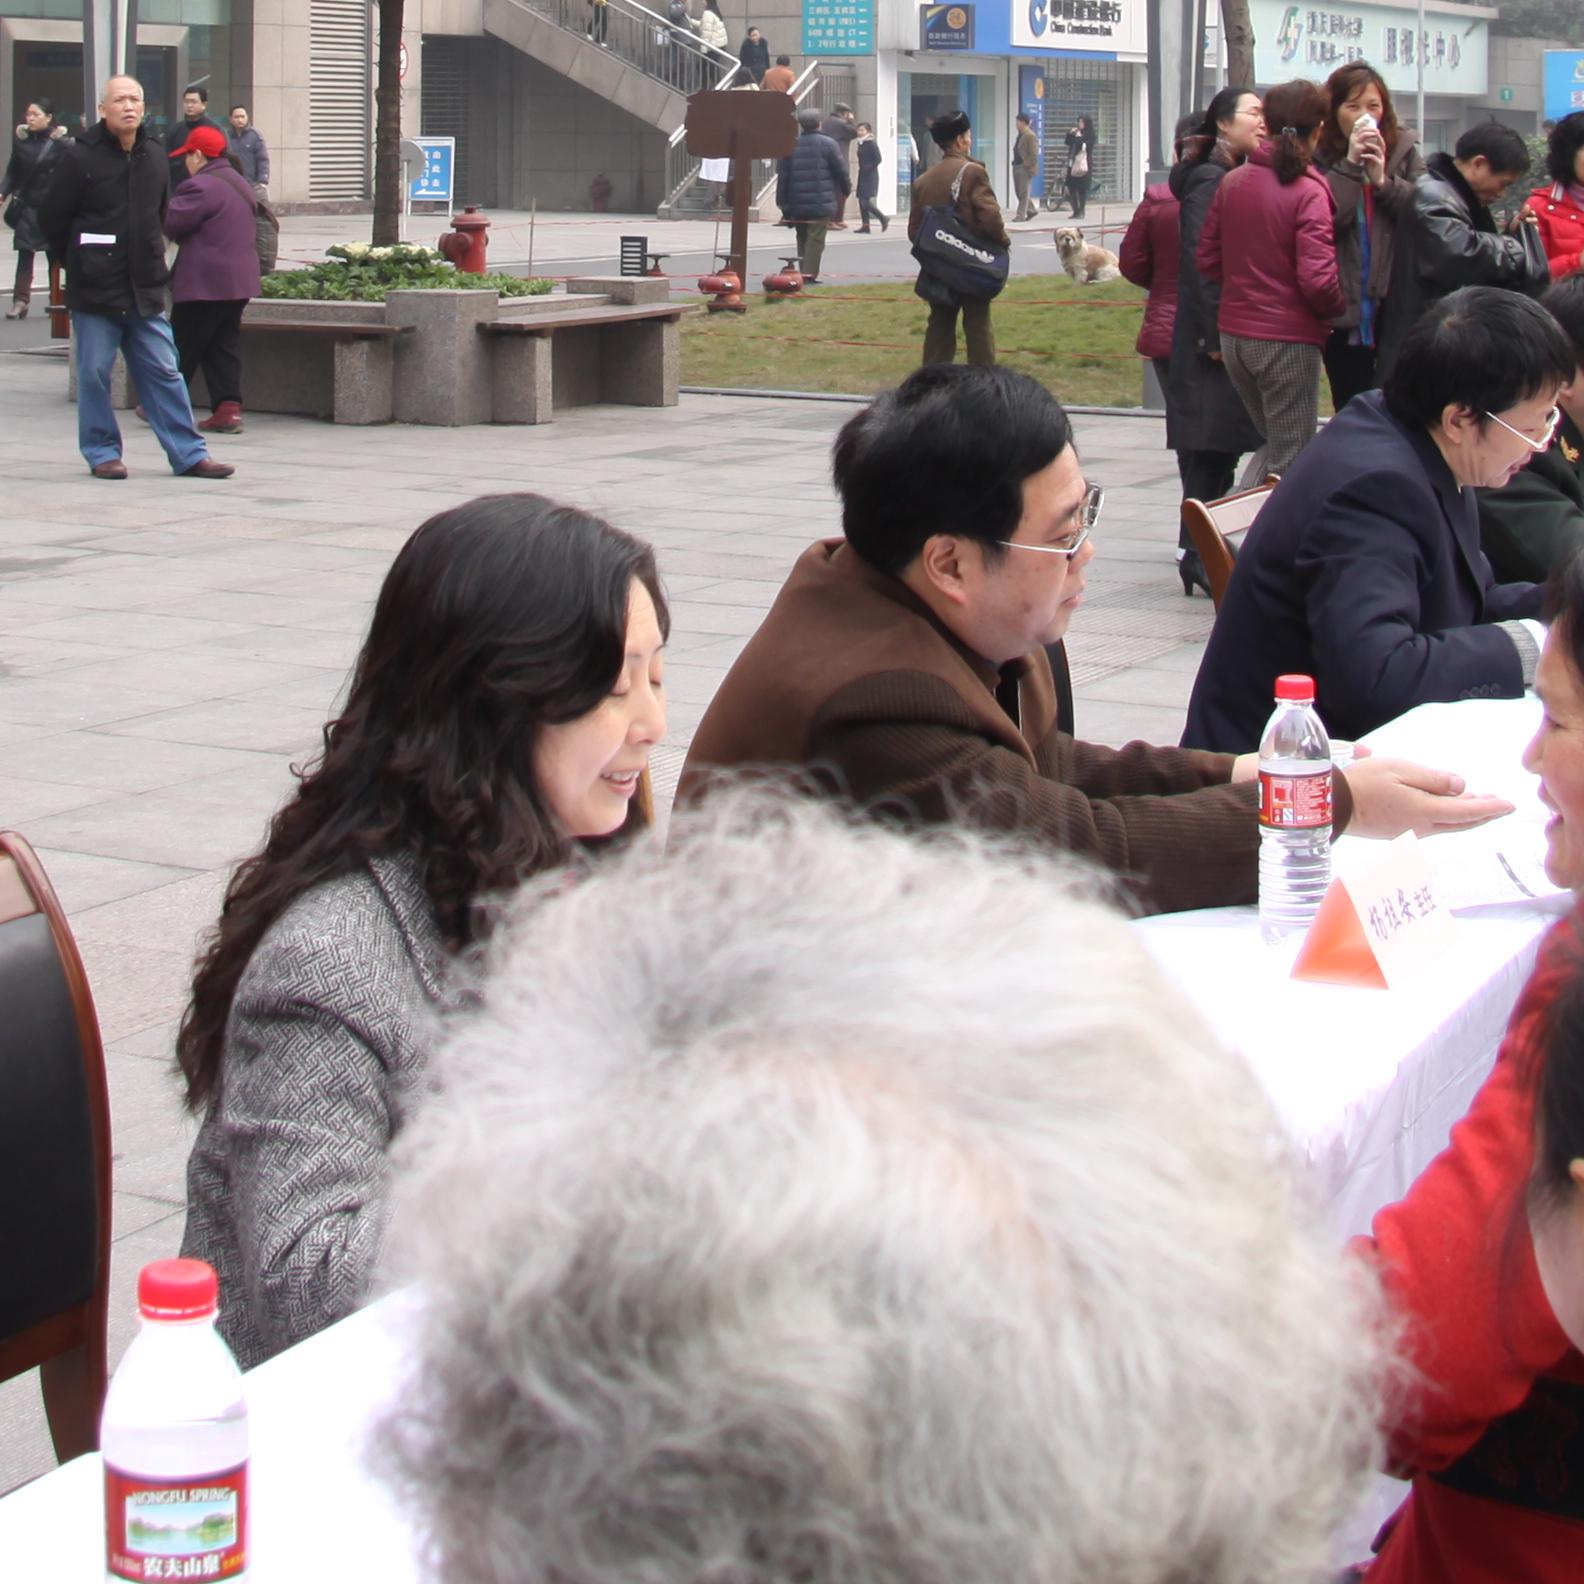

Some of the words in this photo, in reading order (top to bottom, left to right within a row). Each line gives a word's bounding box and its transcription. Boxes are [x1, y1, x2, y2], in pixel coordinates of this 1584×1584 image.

[935, 229, 975, 257] adidas
[131, 1489, 187, 1506] NONGFU
[189, 1487, 231, 1503] SPRING
[143, 1553, 220, 1578] 农夫山泉
